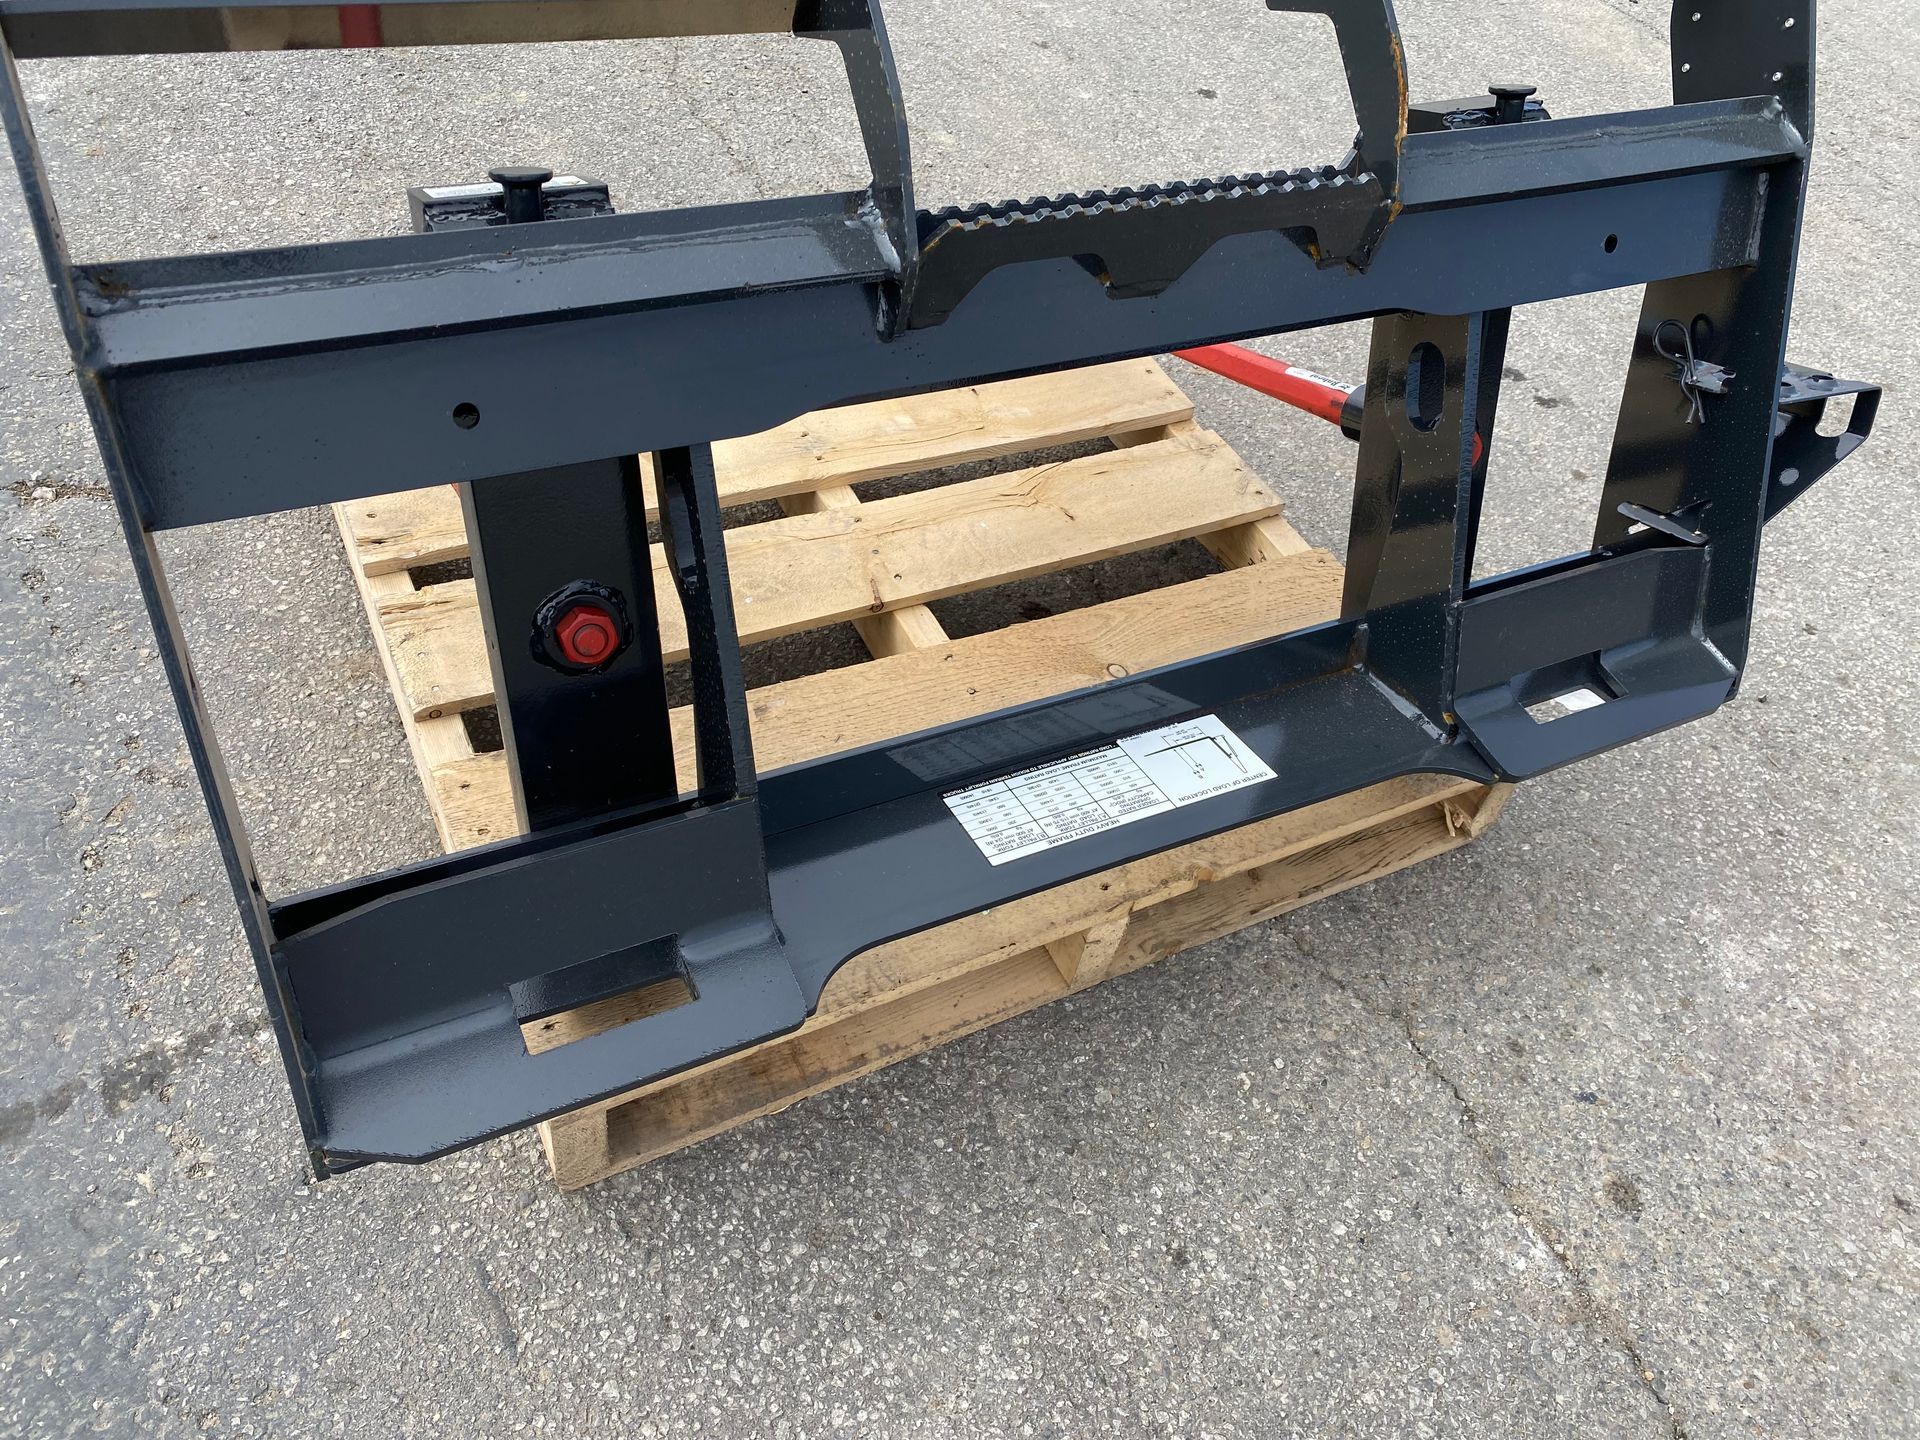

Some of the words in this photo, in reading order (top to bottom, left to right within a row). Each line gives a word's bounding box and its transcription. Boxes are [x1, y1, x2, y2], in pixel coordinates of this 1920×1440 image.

[1037, 757, 1068, 770] APPLICABLE
[1080, 754, 1108, 765] MAXIMUM
[1044, 767, 1061, 775] LOAD
[1061, 762, 1081, 770] FRAME
[1010, 768, 1030, 777] ROUGH
[1023, 772, 1045, 782] RATING
[1240, 771, 1268, 783] CENTER
[988, 774, 1011, 784] TERRAIN
[964, 780, 990, 791] FORKLIFT
[1211, 782, 1232, 792] LOAD
[942, 788, 964, 798] TRUCKS
[1126, 790, 1155, 802] CAPACITY
[1177, 788, 1213, 802] LOCATION
[1118, 796, 1152, 809] OPERATING
[1135, 798, 1161, 809] LOADER
[1117, 805, 1138, 815] RATED
[1077, 817, 1099, 827] PALLET
[1078, 813, 1096, 821] LOAD
[1058, 824, 1076, 833] FORK
[1094, 818, 1121, 830] HEAVY
[1072, 825, 1096, 837] DUTY
[1015, 836, 1038, 847] PALLET
[1017, 832, 1035, 841] LOAD
[1045, 833, 1074, 846] FRAME
[996, 844, 1014, 853] FORK
